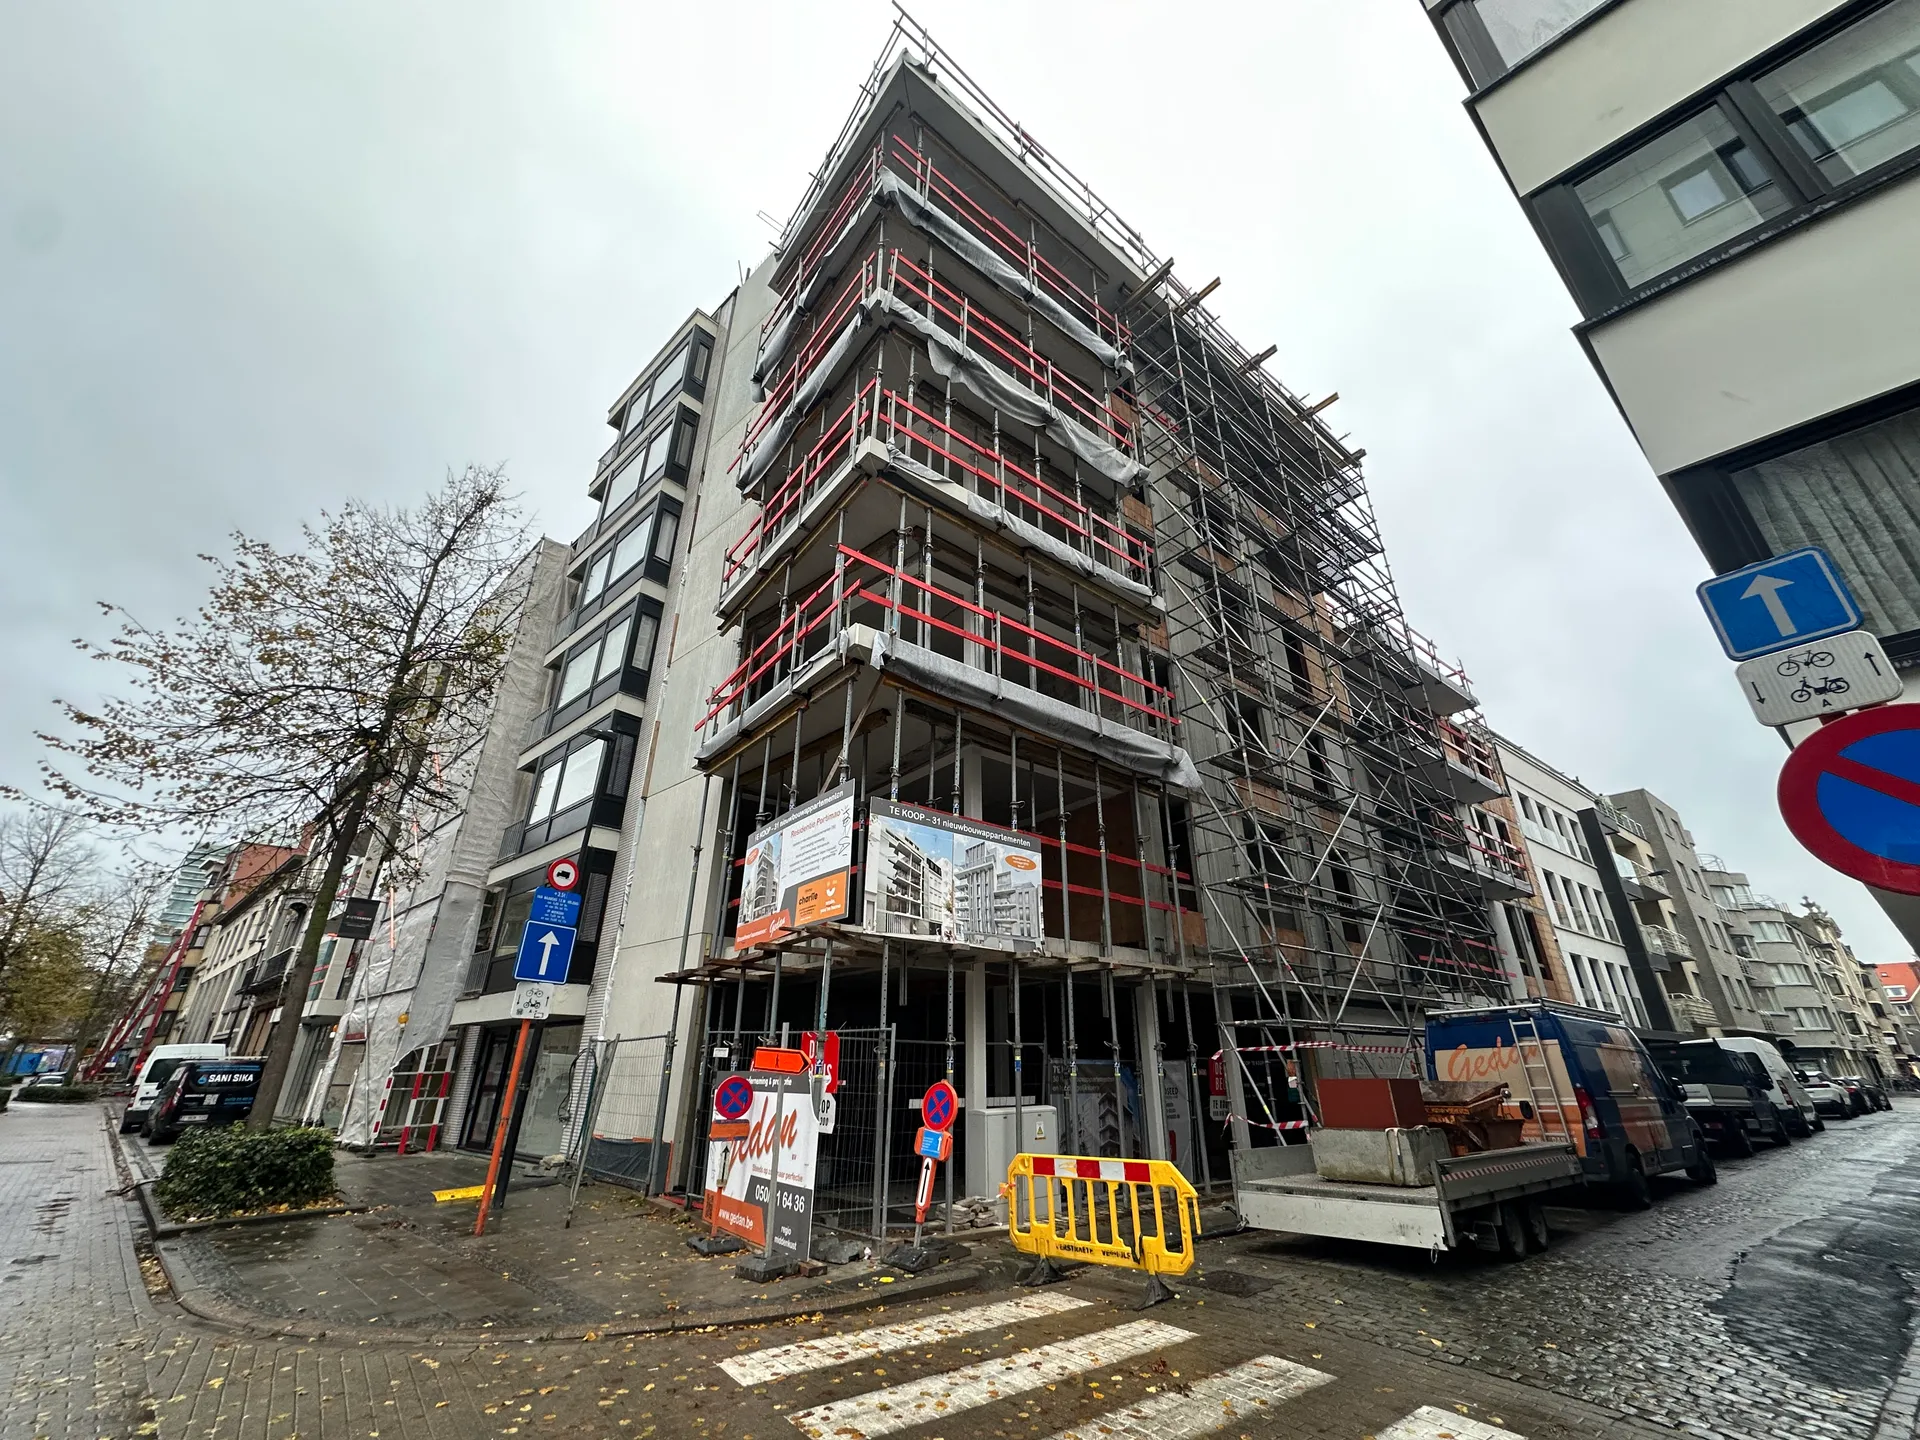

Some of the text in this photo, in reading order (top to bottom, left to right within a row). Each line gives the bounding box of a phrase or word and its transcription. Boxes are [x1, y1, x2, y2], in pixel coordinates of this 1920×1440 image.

[889, 805, 900, 817] TE
[901, 808, 926, 822] KOOP
[932, 816, 941, 826] 31
[942, 819, 1031, 848] nieuwbouwappartementen
[208, 1073, 254, 1083] SANI SIKA
[782, 1191, 793, 1210] 64
[793, 1194, 805, 1213] 36
[718, 1208, 754, 1231] www.gedan.be
[780, 1226, 792, 1236] regio
